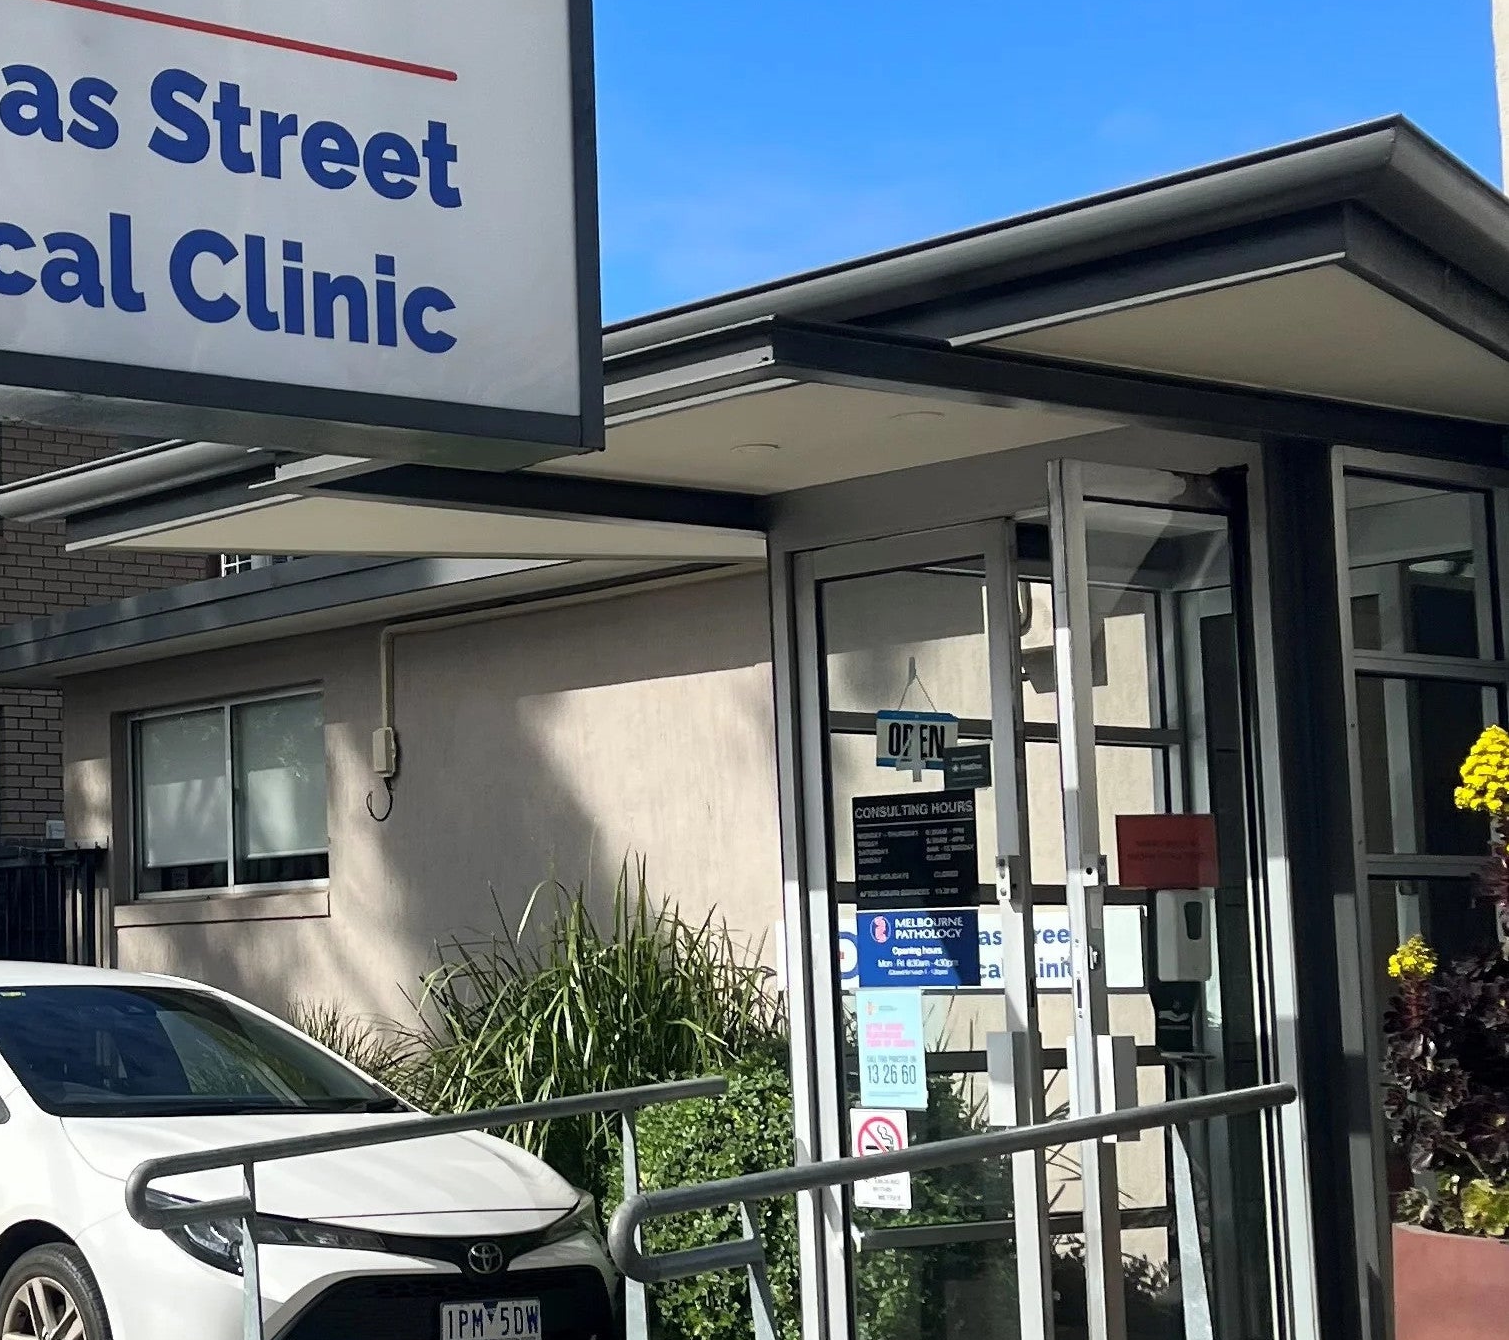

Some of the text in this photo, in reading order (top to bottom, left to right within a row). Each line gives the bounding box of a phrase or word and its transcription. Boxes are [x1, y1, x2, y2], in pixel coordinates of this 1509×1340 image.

[148, 68, 463, 209] Street
[169, 228, 458, 355] Clinic
[888, 722, 946, 760] OPEN
[854, 800, 974, 819] CONSULTING HOURS
[894, 916, 964, 928] MELBOURNE
[895, 928, 963, 940] PATHOLOGY
[891, 945, 943, 956] Opening hours
[877, 959, 893, 968] Mon
[867, 1063, 917, 1085] 13 26 60
[448, 1306, 539, 1339] 1PM 5DW
